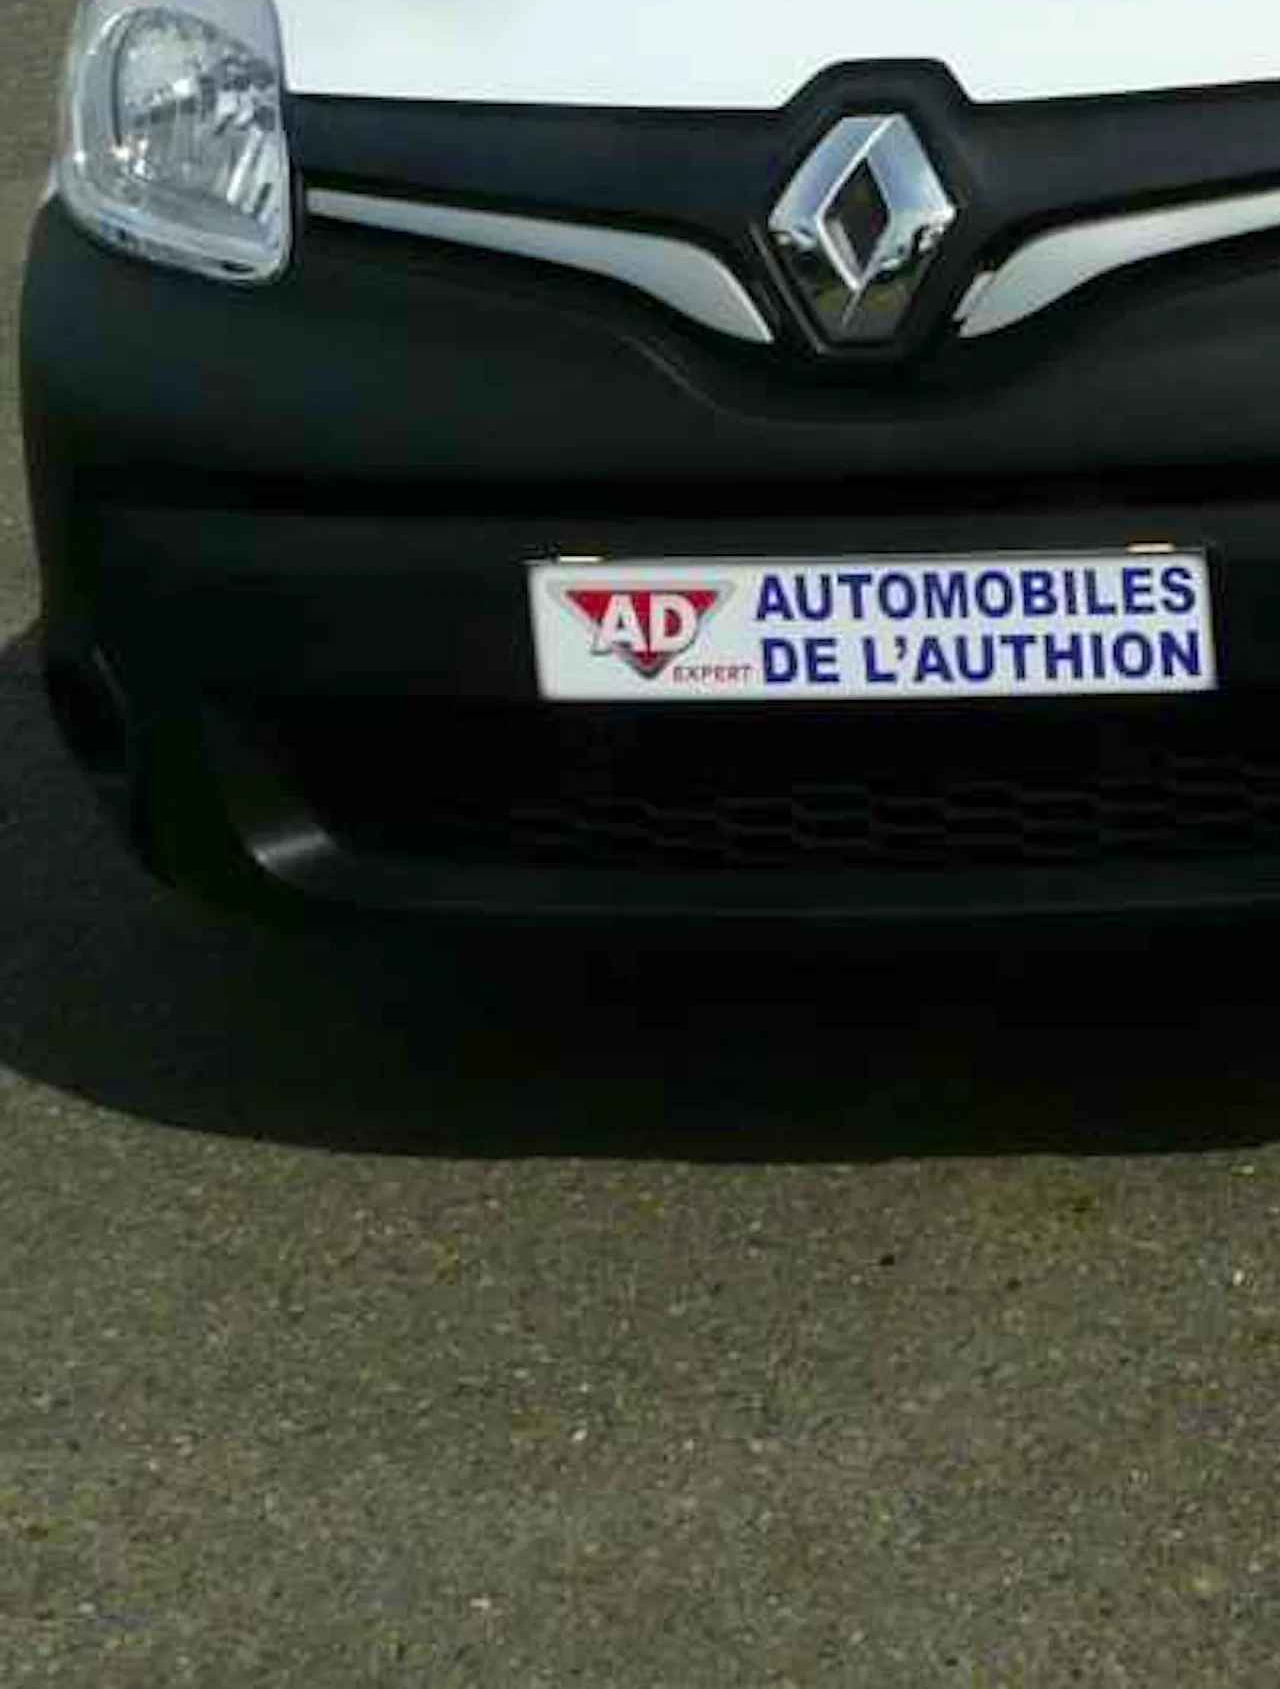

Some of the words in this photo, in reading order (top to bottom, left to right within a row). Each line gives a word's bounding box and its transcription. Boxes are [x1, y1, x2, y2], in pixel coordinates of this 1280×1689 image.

[756, 566, 1196, 621] AUTOMOBILES
[591, 593, 701, 654] AD
[672, 663, 751, 682] EXPERT
[762, 637, 840, 684] DE
[864, 631, 1201, 684] L'AUTHION
